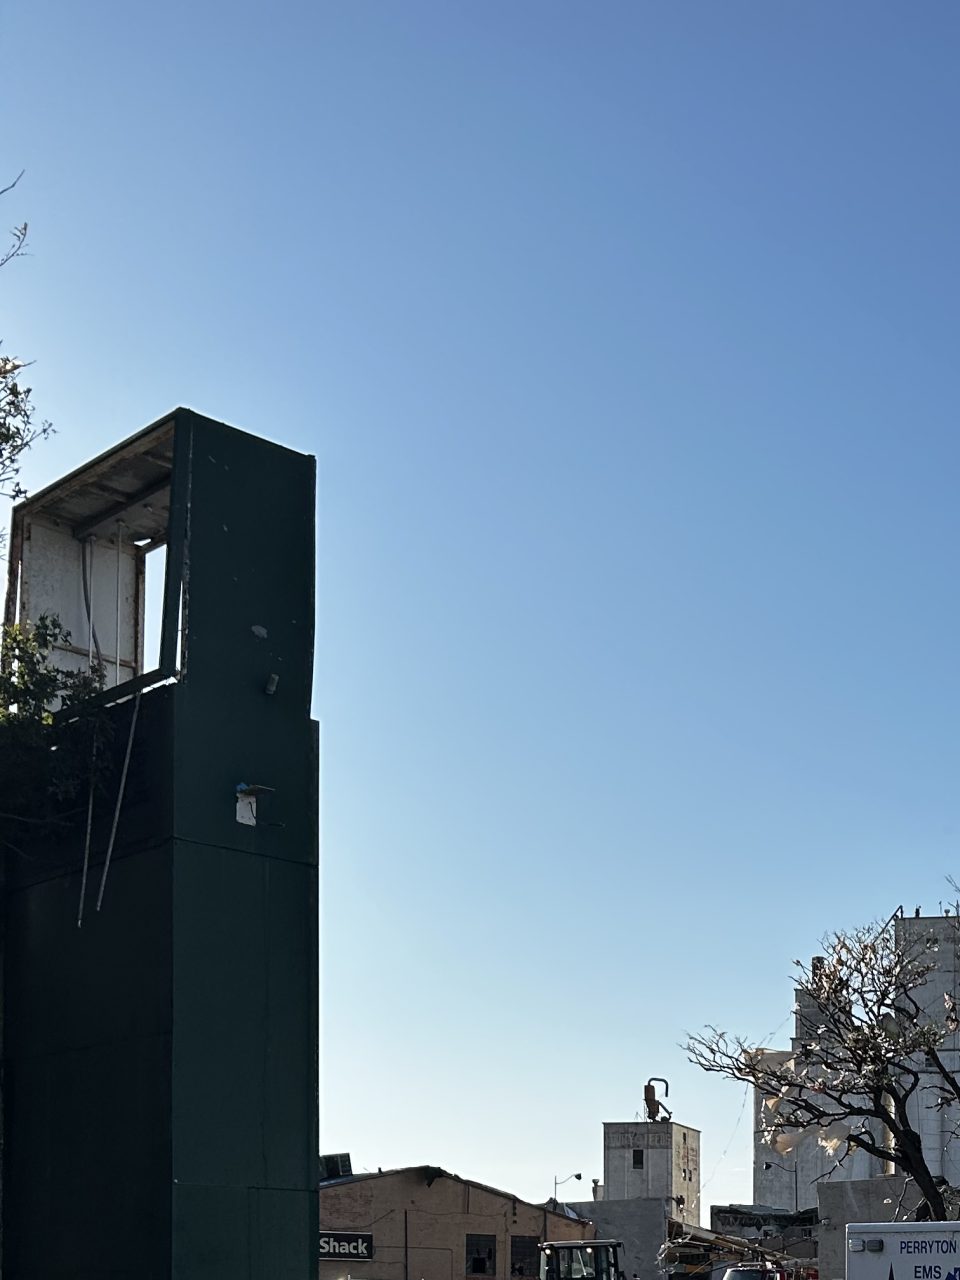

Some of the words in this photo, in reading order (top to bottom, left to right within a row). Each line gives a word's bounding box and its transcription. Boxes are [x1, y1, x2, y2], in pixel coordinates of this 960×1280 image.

[319, 1237, 368, 1254] Shack
[900, 1240, 957, 1254] PERRYTON
[914, 1265, 942, 1279] EMS
